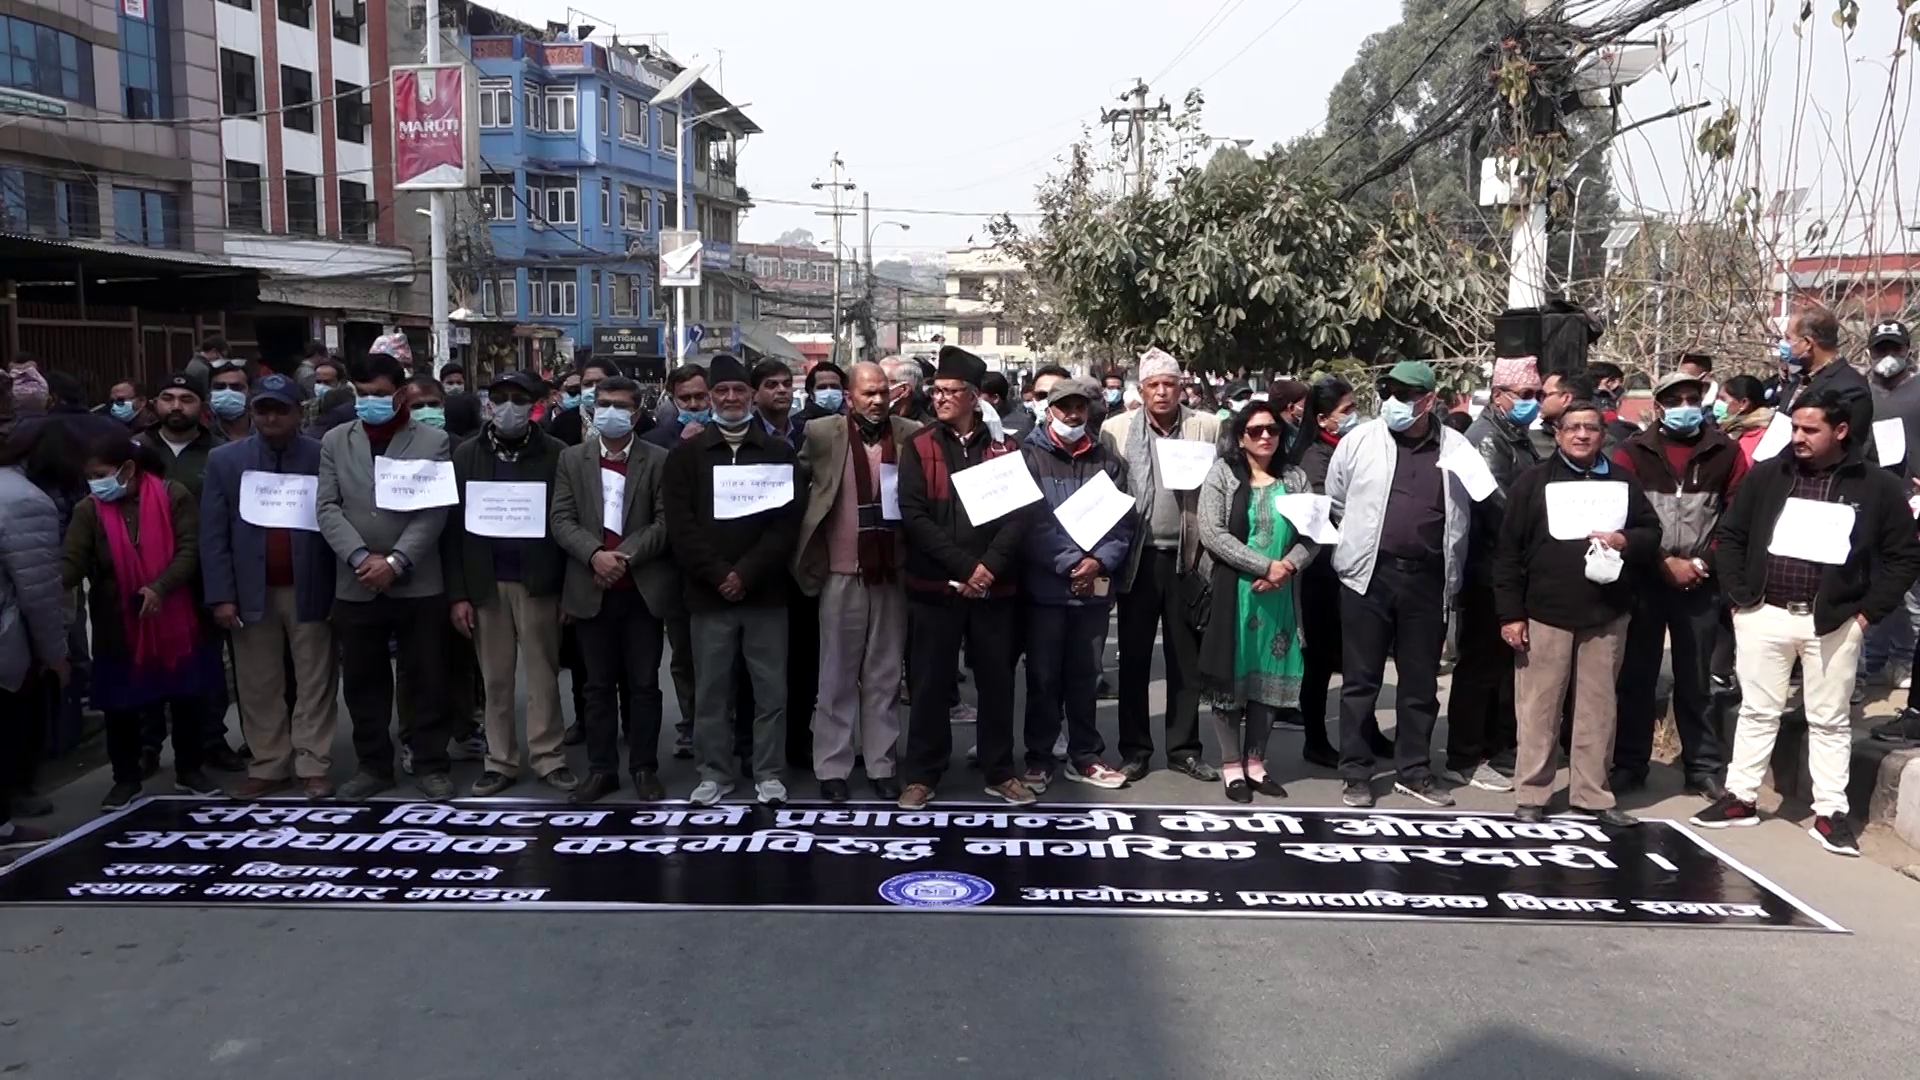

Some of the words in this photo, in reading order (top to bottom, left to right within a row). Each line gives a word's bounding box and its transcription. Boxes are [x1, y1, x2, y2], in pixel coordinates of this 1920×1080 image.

[399, 119, 459, 134] MARUTI
[600, 334, 649, 343] MAITIGHAR
[613, 343, 636, 351] CAFE
[188, 803, 371, 826] संसद
[379, 803, 615, 828] विघटन
[630, 804, 752, 828] गर्ने
[773, 808, 1136, 832] प्रधानमन्त्री
[1158, 810, 1305, 835] केपी
[1325, 814, 1612, 843] ओलीको
[104, 826, 538, 855] असंवैधानिक
[963, 834, 1258, 861] नागरिक
[1278, 842, 1620, 870] खबरदारी
[231, 860, 359, 879] बिहान
[366, 867, 420, 881] ११
[429, 864, 504, 882] बजे
[202, 880, 399, 901] माइतीघर
[1235, 888, 1489, 909] प्रजातान्त्रिक
[1496, 892, 1626, 915] विचार
[1629, 899, 1773, 919] समाज
